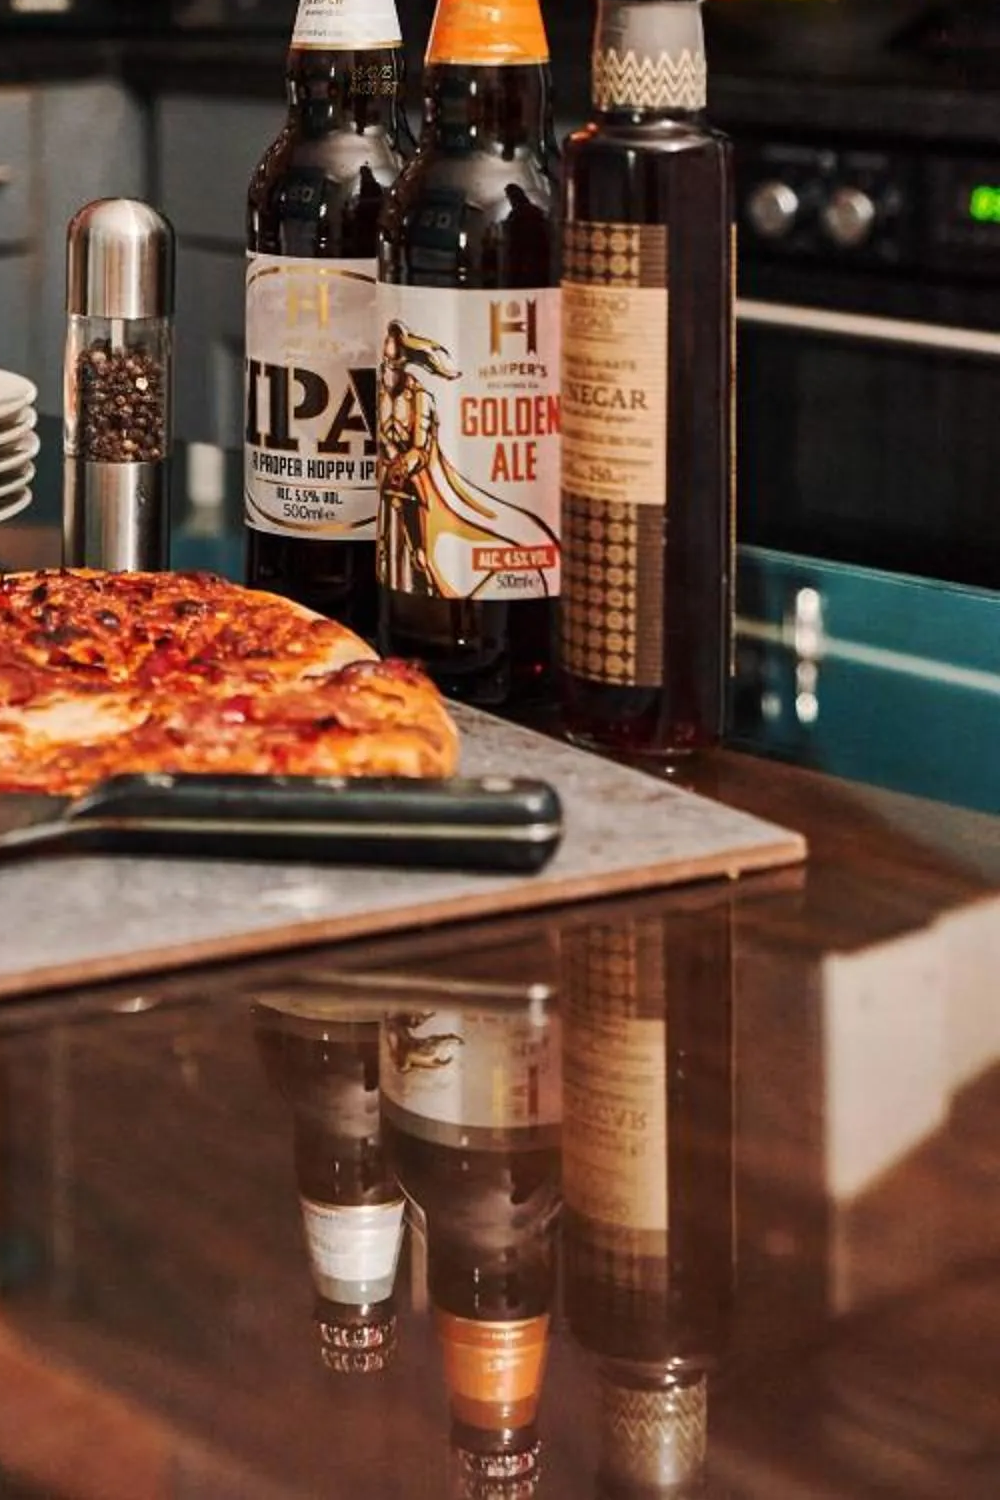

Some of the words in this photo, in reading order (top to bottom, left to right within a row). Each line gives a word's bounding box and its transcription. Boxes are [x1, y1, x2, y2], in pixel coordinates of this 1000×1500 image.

[246, 358, 377, 456] IPA
[460, 395, 561, 437] GOLDEN
[260, 453, 303, 477] PROPER
[307, 459, 355, 480] HOPPY
[360, 461, 377, 481] IP
[491, 441, 537, 482] ALE
[295, 488, 320, 503] 5.5%
